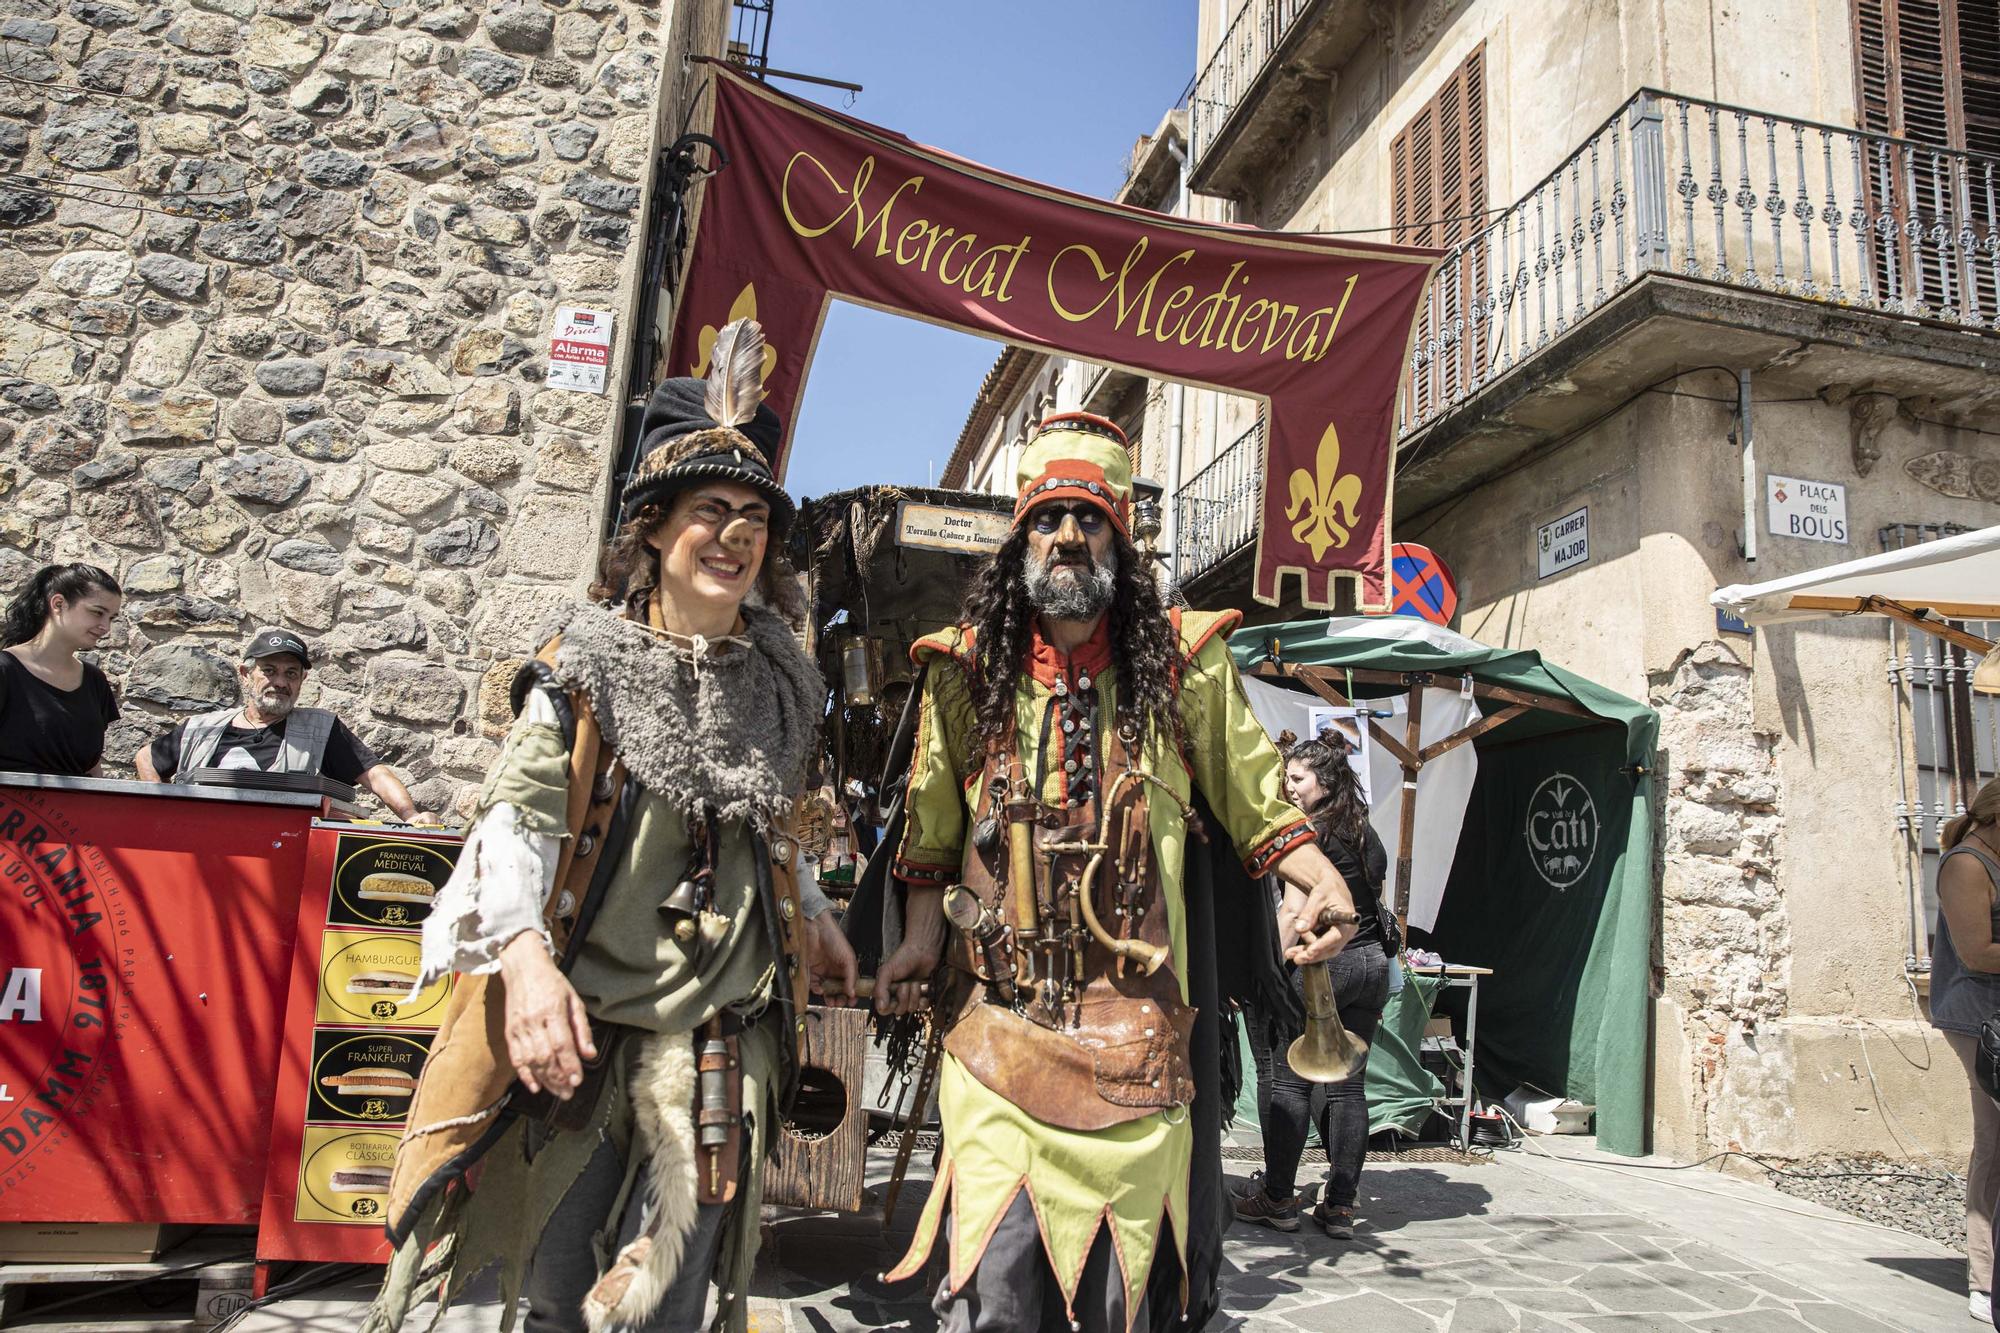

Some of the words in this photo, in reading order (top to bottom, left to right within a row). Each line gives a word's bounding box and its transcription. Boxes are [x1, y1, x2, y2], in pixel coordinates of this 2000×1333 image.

[783, 152, 1031, 302] Mercat
[1048, 236, 1359, 362] Medieval
[555, 343, 605, 357] Alarma
[1800, 484, 1837, 503] PLAÇA
[1810, 504, 1828, 514] DELS
[944, 516, 973, 528] Doctor
[1555, 515, 1585, 539] CARRER
[1790, 514, 1845, 540] BOUS
[906, 525, 937, 537] Torralbo
[1554, 539, 1586, 565] MAJOR
[380, 851, 424, 861] FRANKFURT
[374, 860, 427, 872] MEDIEVAL
[83, 841, 120, 897] MUNICH
[113, 902, 130, 937] 1906
[122, 948, 136, 998] PARIS
[73, 957, 108, 1030] 1876
[368, 1045, 392, 1053] SUPER
[348, 1052, 413, 1063] FRANKFURT
[0, 1049, 92, 1156] DAMM
[350, 1143, 393, 1151] BOTIFARRA
